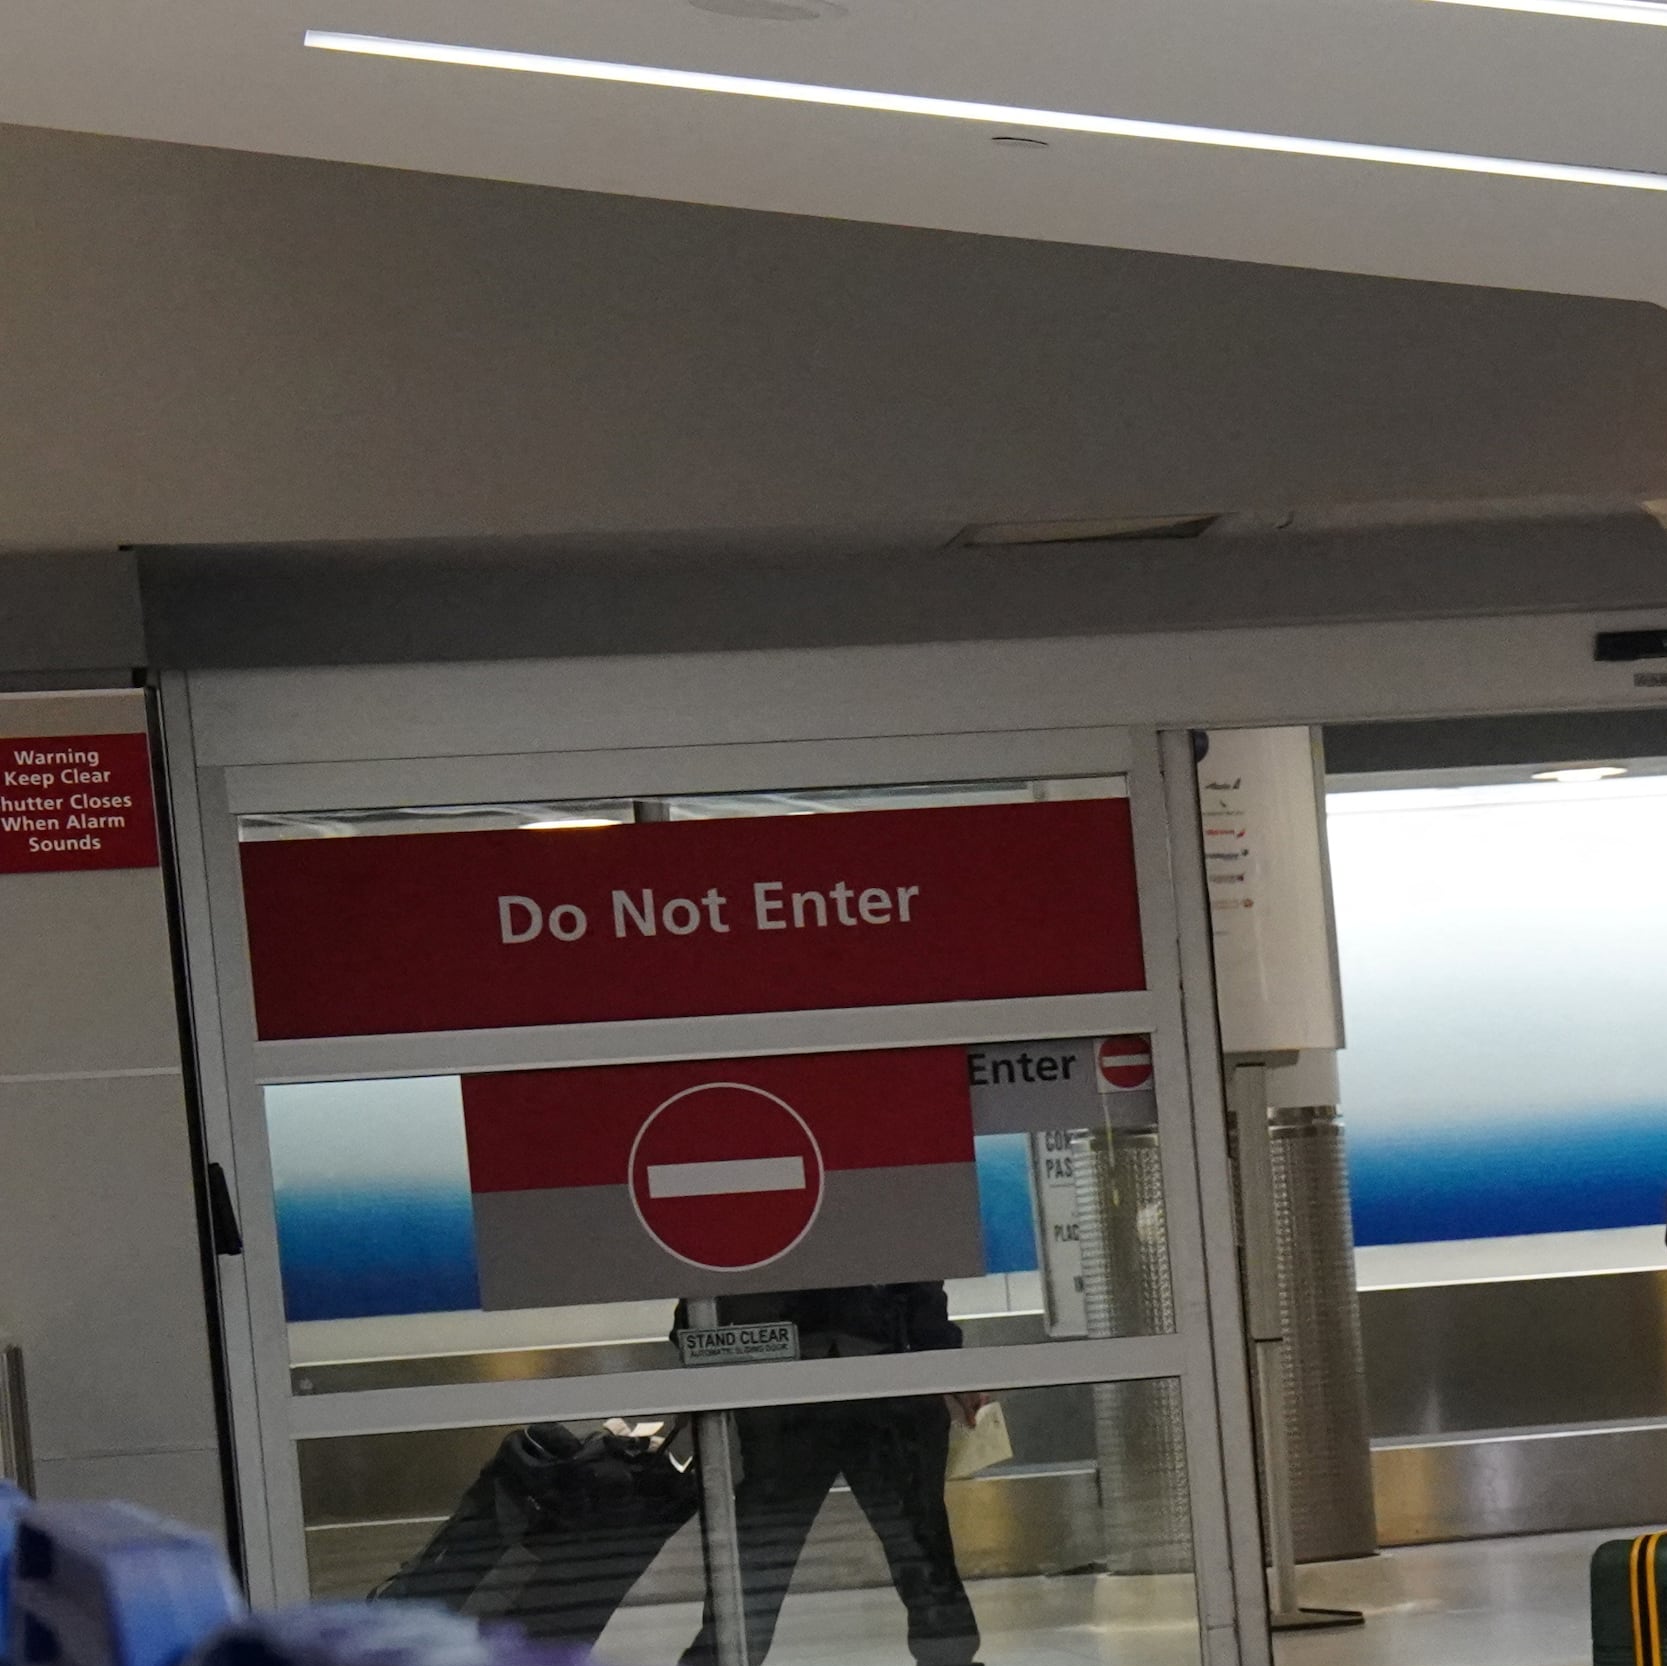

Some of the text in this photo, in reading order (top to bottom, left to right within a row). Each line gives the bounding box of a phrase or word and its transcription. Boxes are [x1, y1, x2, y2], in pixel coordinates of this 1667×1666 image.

[13, 748, 100, 767] Warning
[4, 768, 111, 789] Keep Clear
[0, 793, 132, 812] hutter Closes
[0, 813, 125, 832] When Alarm
[28, 834, 101, 852] Sounds
[498, 881, 920, 944] Do Not Enter
[967, 1052, 1076, 1086] Enter
[686, 1327, 790, 1349] STAND CLEAR
